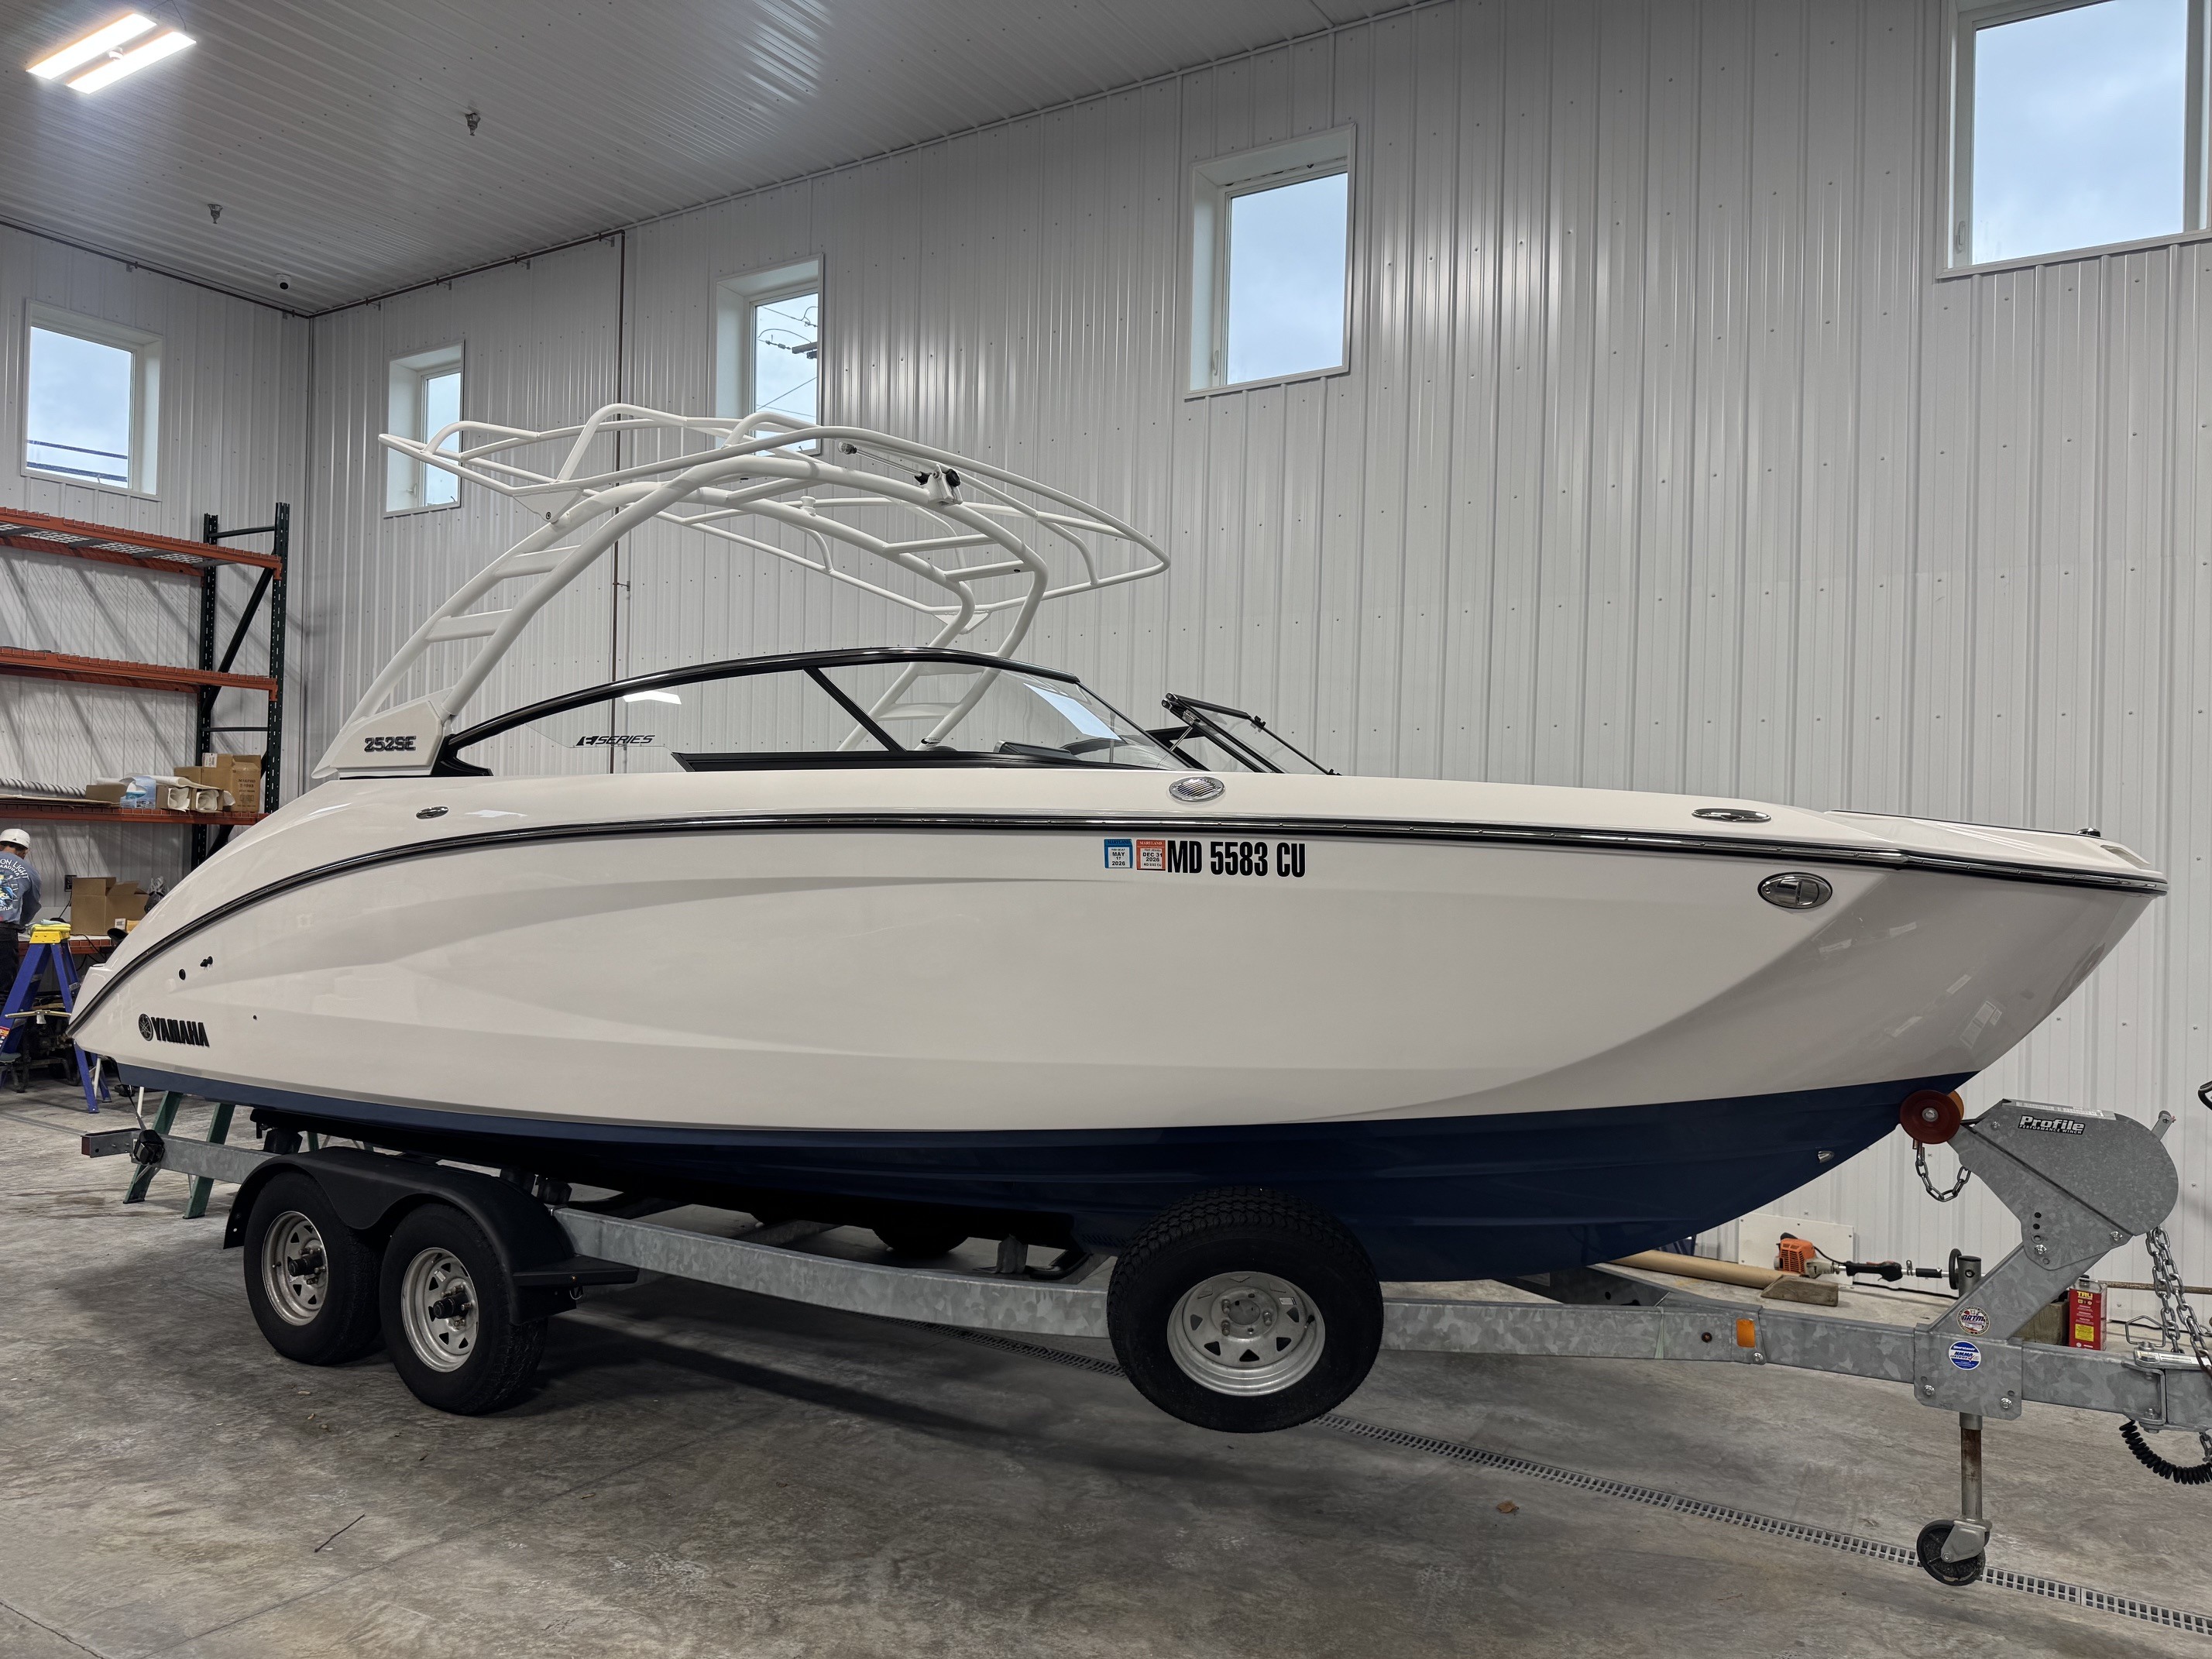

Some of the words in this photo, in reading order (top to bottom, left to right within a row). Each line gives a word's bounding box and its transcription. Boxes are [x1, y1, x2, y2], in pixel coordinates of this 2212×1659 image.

[364, 736, 417, 752] 252SE
[1167, 840, 1202, 874] MD
[1210, 841, 1268, 877] 5583
[1276, 842, 1306, 878] CU
[12, 860, 31, 882] LIGHT
[150, 1016, 210, 1047] YAMAHA
[2019, 1115, 2085, 1131] Profile
